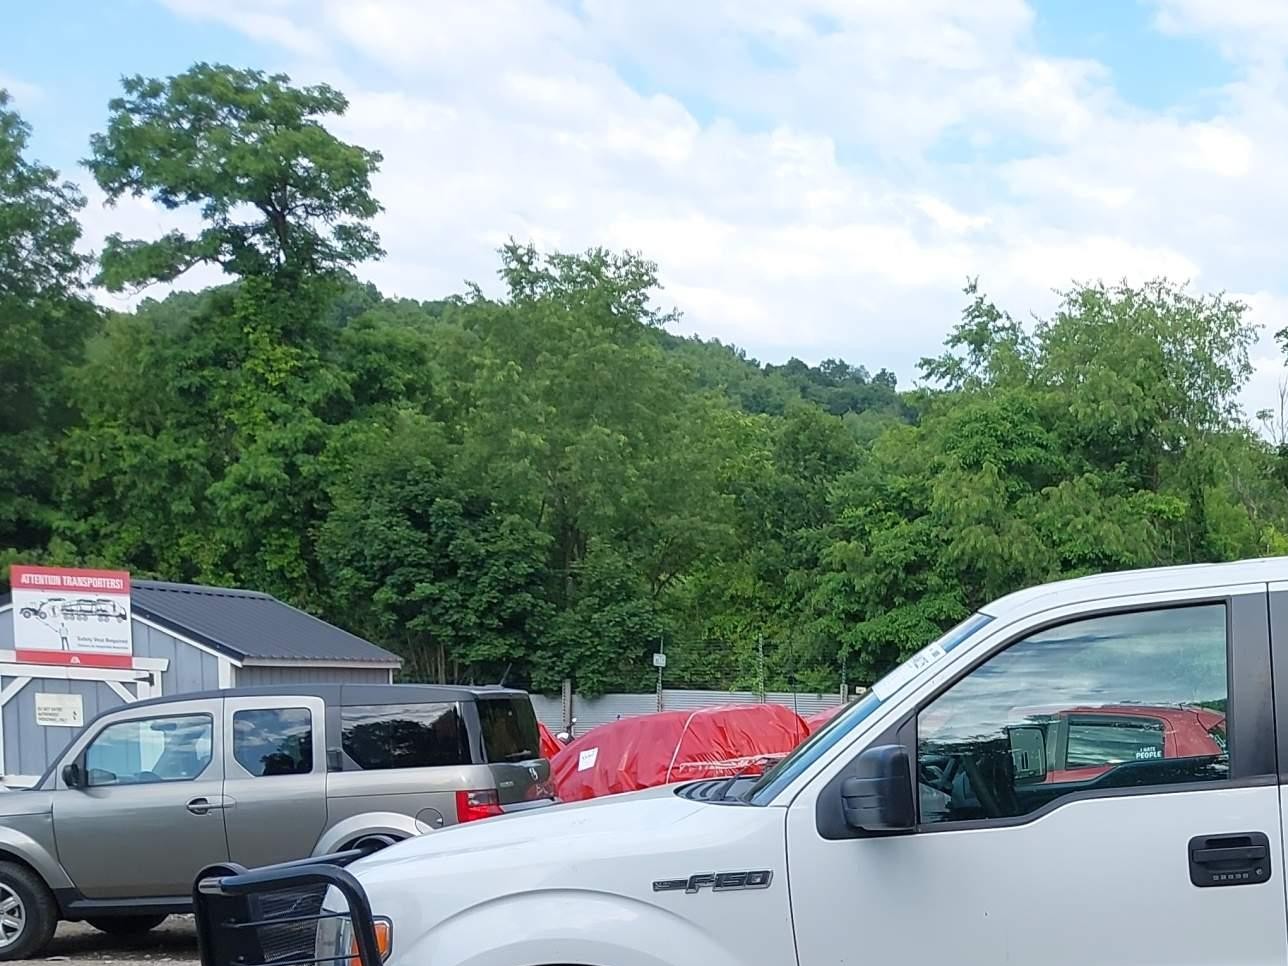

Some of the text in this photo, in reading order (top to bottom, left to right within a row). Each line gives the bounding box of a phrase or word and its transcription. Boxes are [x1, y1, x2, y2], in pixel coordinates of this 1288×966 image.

[20, 573, 124, 589] ATTENTION TRANSPORTERS!
[1136, 750, 1162, 759] PEOPLE
